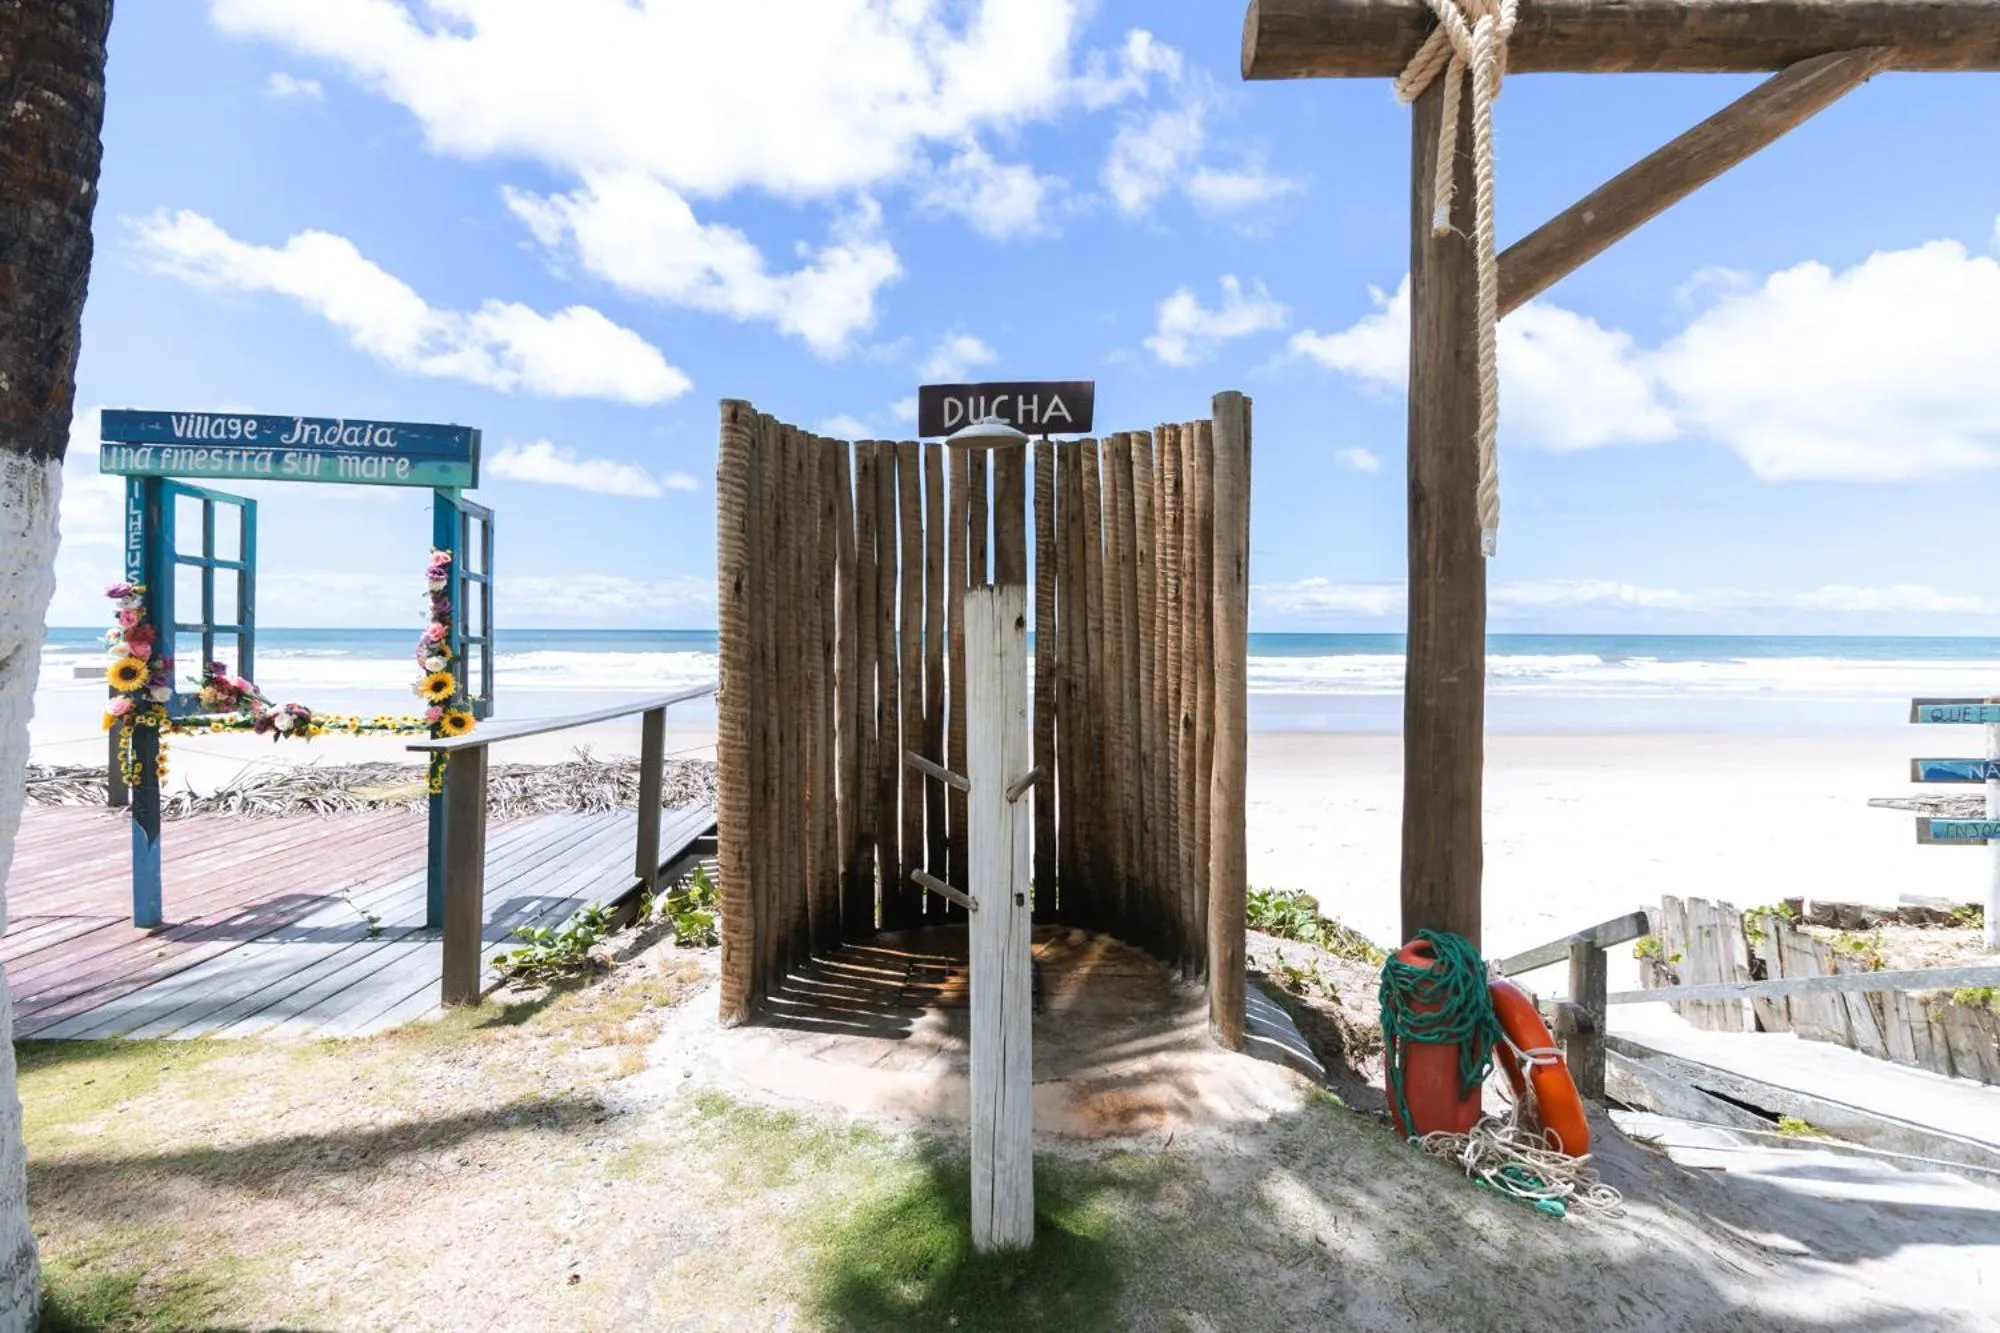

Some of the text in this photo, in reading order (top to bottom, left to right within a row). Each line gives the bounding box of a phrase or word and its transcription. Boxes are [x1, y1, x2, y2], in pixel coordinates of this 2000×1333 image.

[943, 394, 1073, 428] DUCHA
[171, 414, 258, 440] Village
[337, 454, 410, 480] mare
